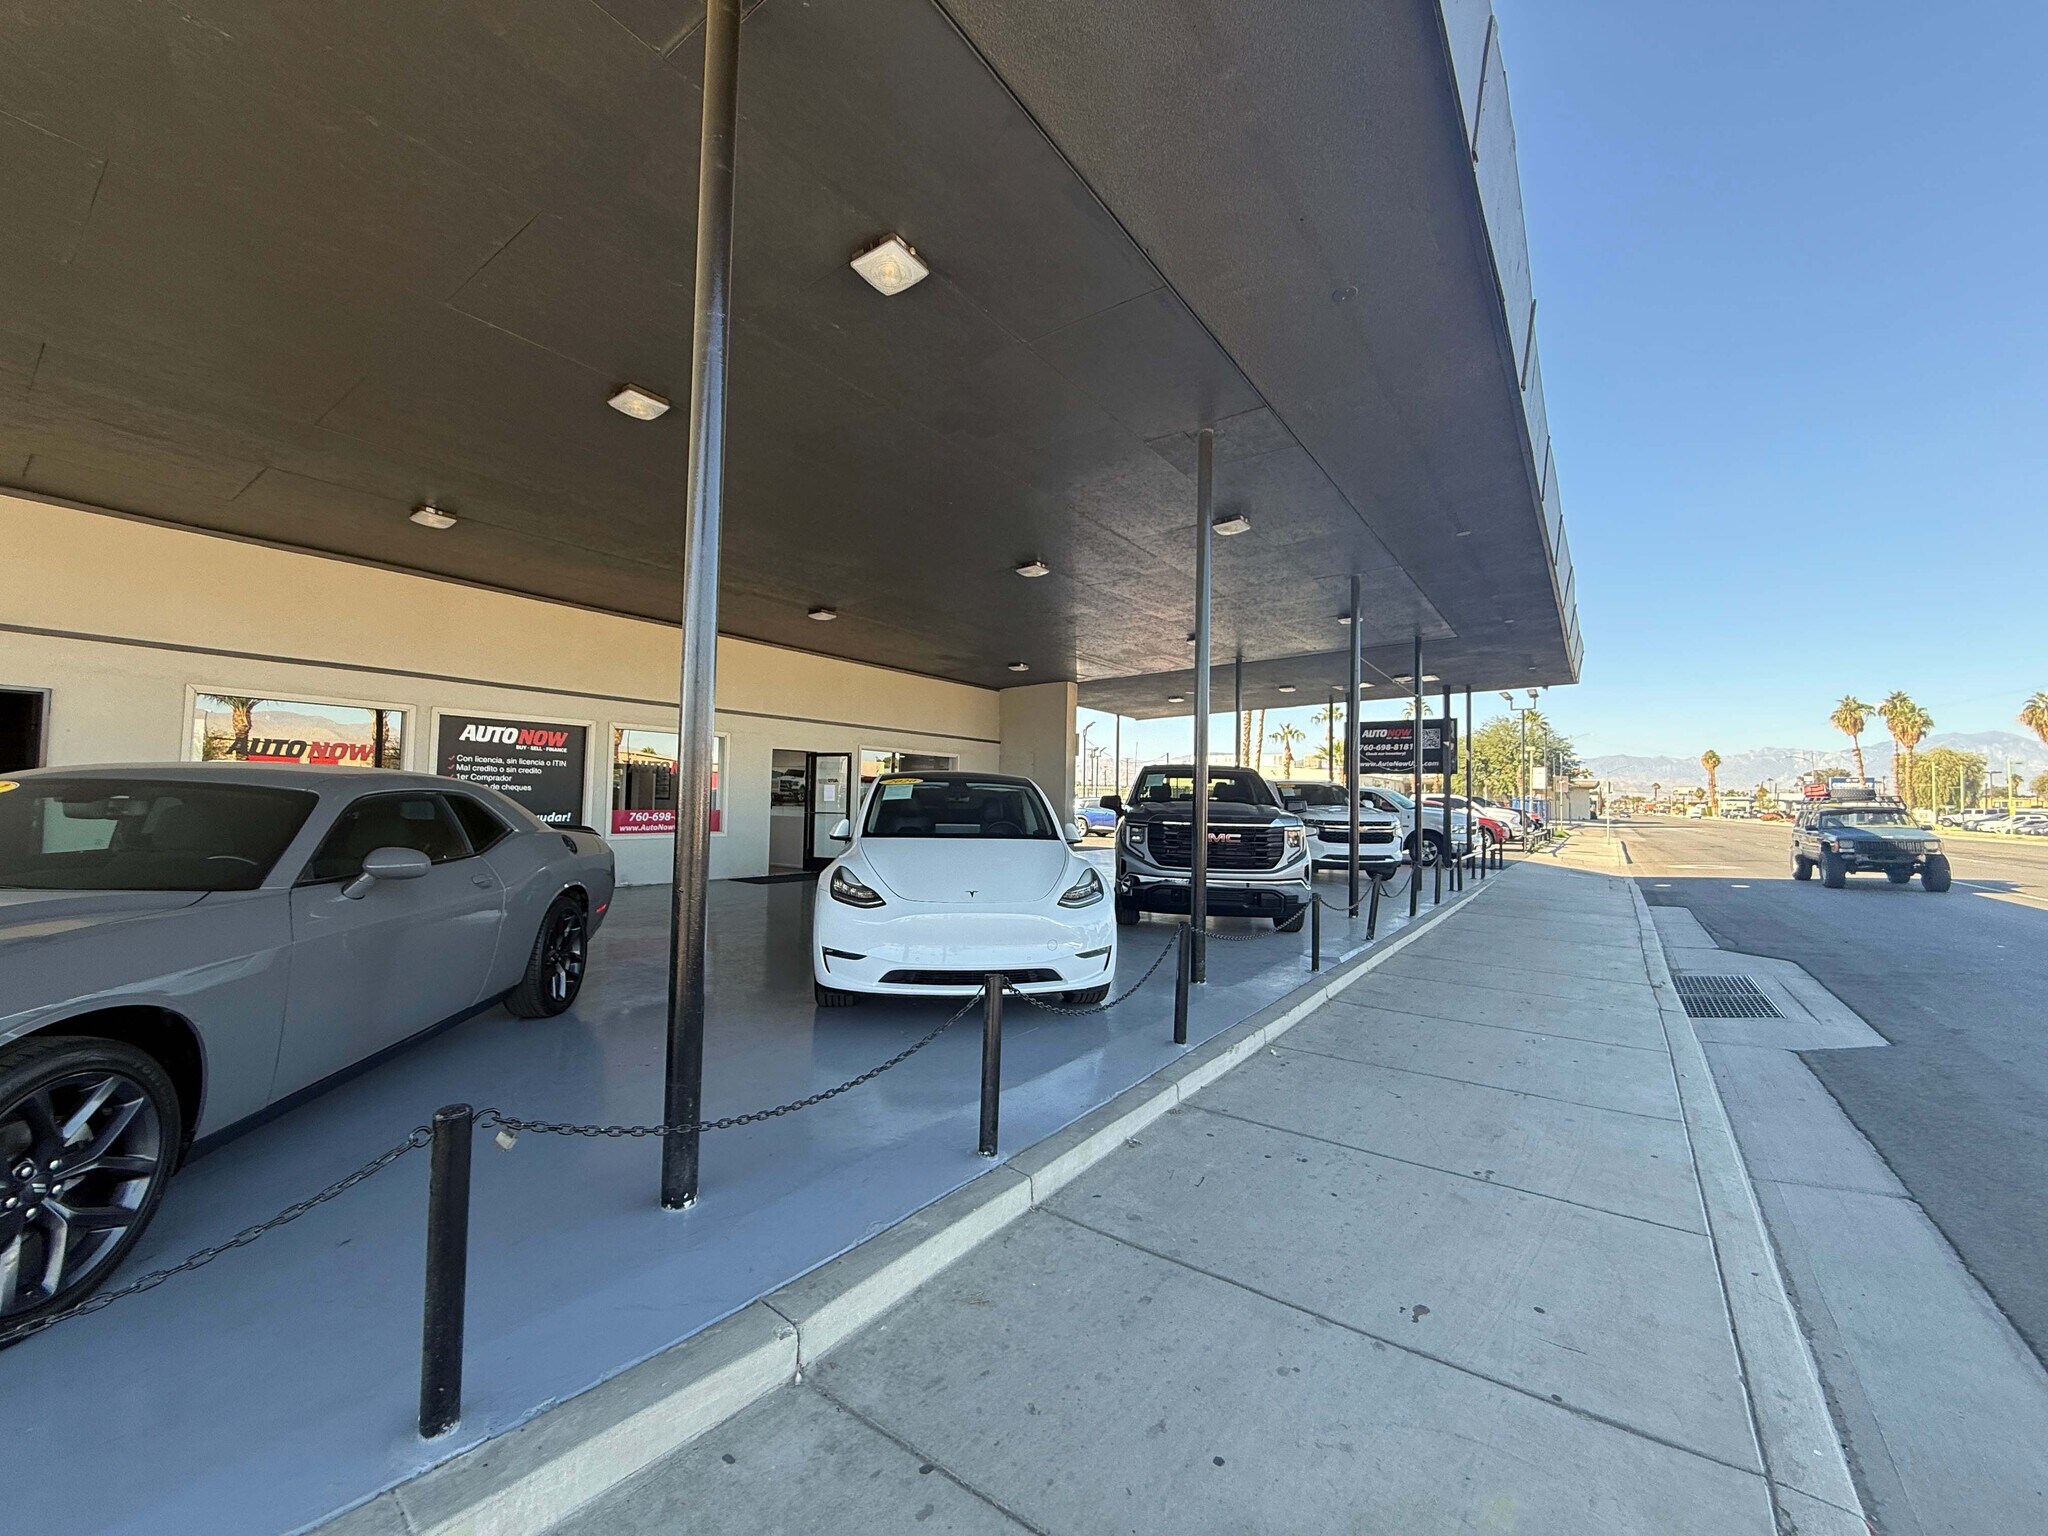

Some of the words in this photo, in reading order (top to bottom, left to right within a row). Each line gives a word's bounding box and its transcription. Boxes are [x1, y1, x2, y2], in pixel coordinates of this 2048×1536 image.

[459, 724, 519, 744] AUTO
[517, 729, 569, 747] NOW
[1361, 729, 1388, 738] AUTO
[1387, 729, 1412, 737] NOW
[226, 737, 308, 758] AUTO
[307, 741, 376, 761] NOW
[1360, 743, 1413, 751] 760-698-8181
[456, 754, 473, 763] Con
[474, 755, 505, 765] licencia,
[518, 758, 545, 767] licencia
[456, 763, 471, 771] Mal
[471, 765, 499, 773] credito
[517, 767, 543, 775] credito
[469, 773, 513, 783] Comprador
[500, 784, 532, 792] cheques
[629, 812, 675, 821] 760-698-
[1207, 833, 1241, 843] MC
